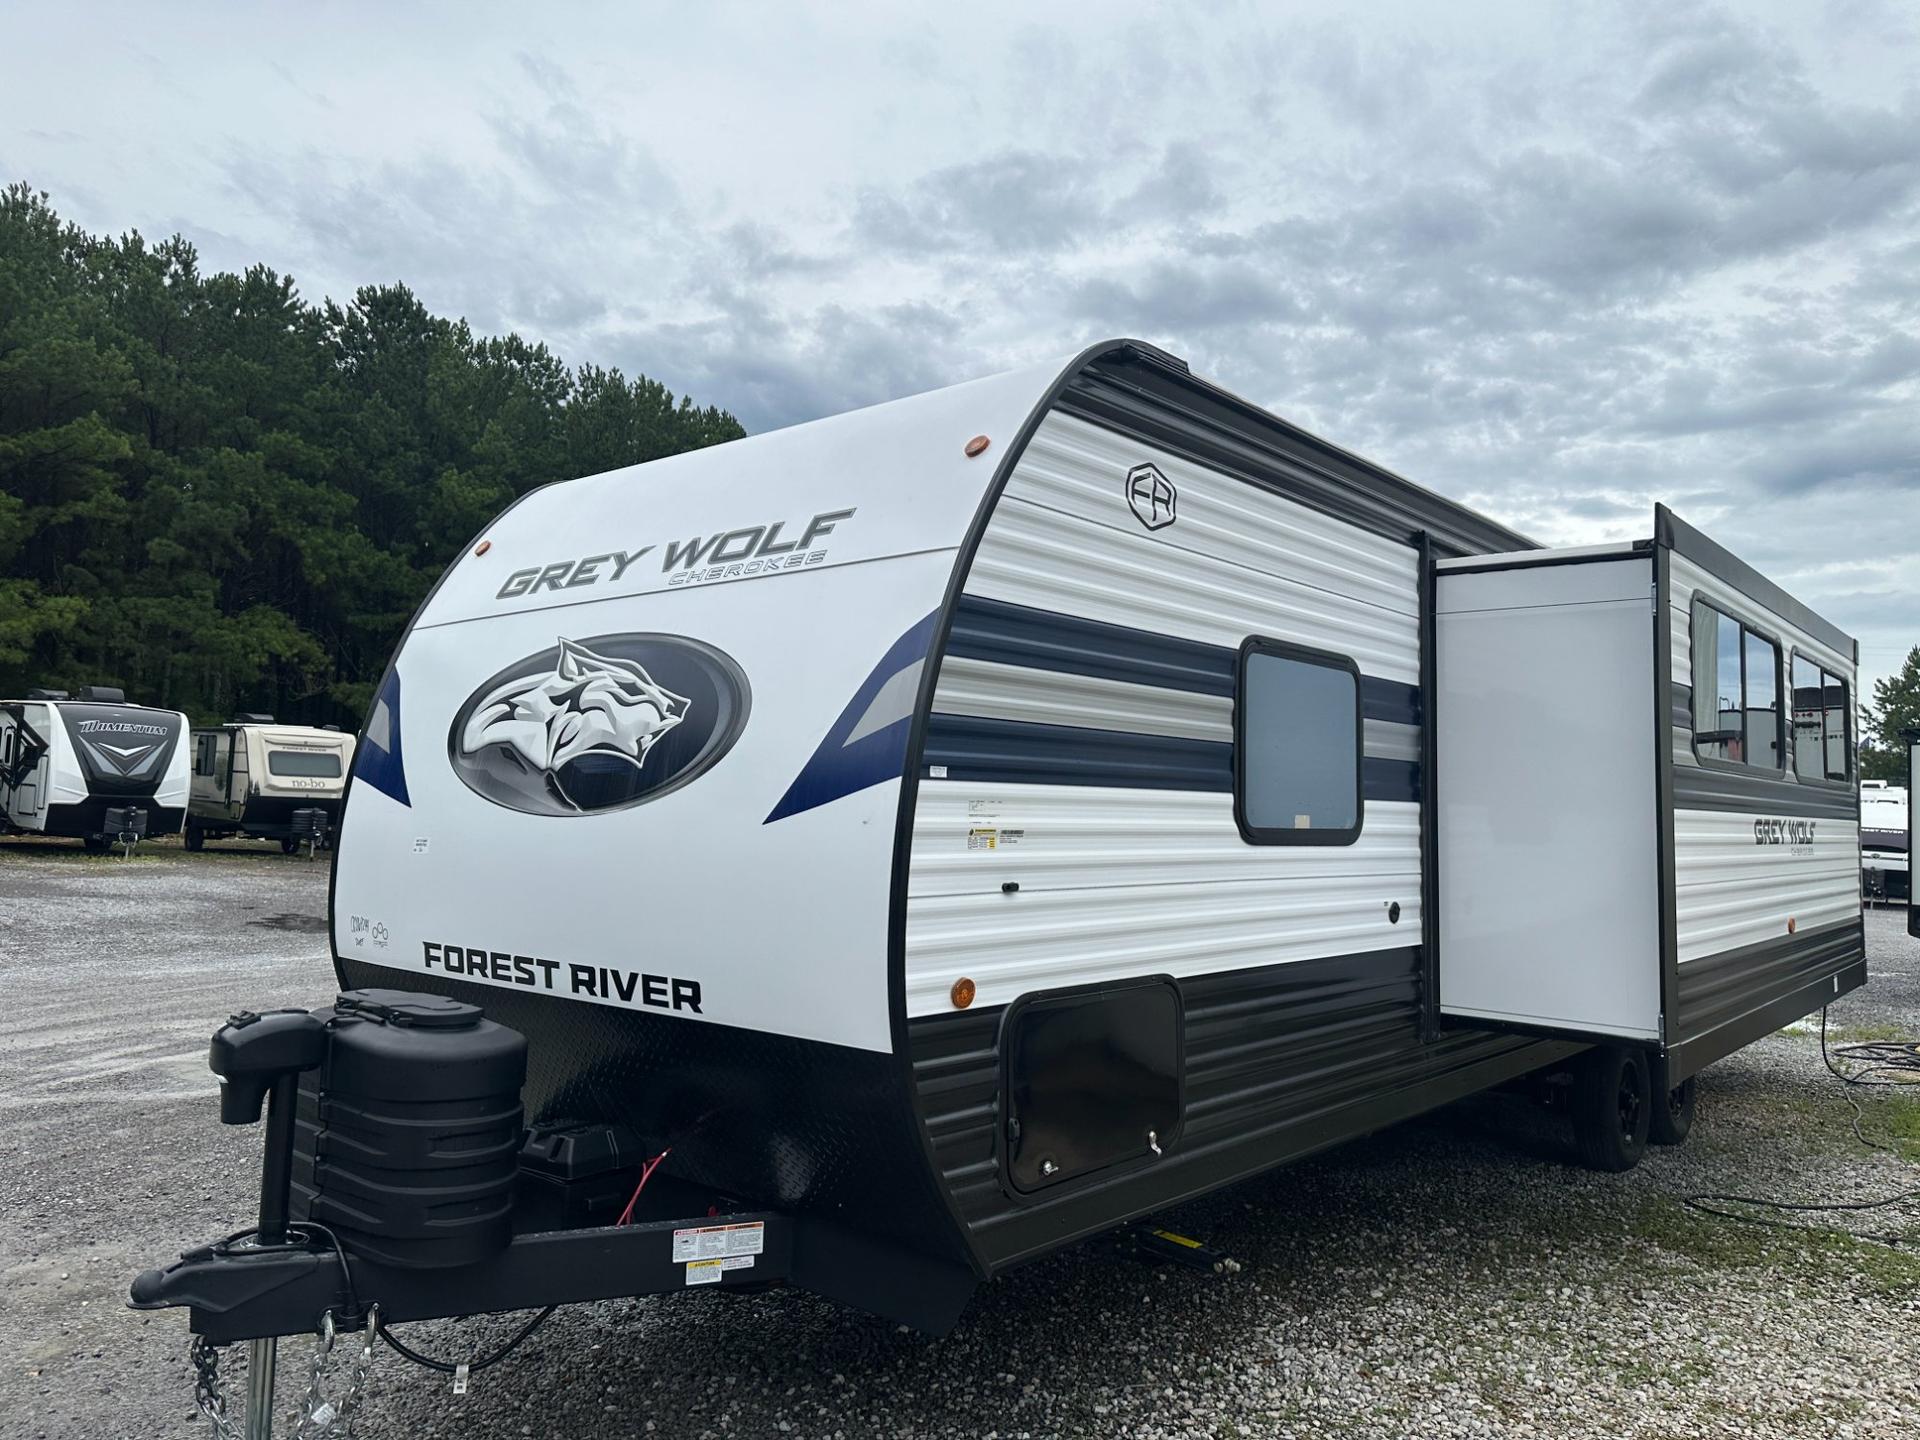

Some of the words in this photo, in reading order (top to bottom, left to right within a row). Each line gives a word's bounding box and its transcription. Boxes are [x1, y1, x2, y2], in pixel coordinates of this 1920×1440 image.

[495, 545, 657, 600] GREY
[662, 507, 858, 573] WOLF
[668, 549, 828, 586] CHEROKEE
[77, 720, 168, 735] MOMENTUM
[1754, 819, 1787, 845] GREY
[1788, 820, 1816, 845] WOLF
[422, 941, 560, 989] FOREST
[568, 962, 704, 1014] RIVER
